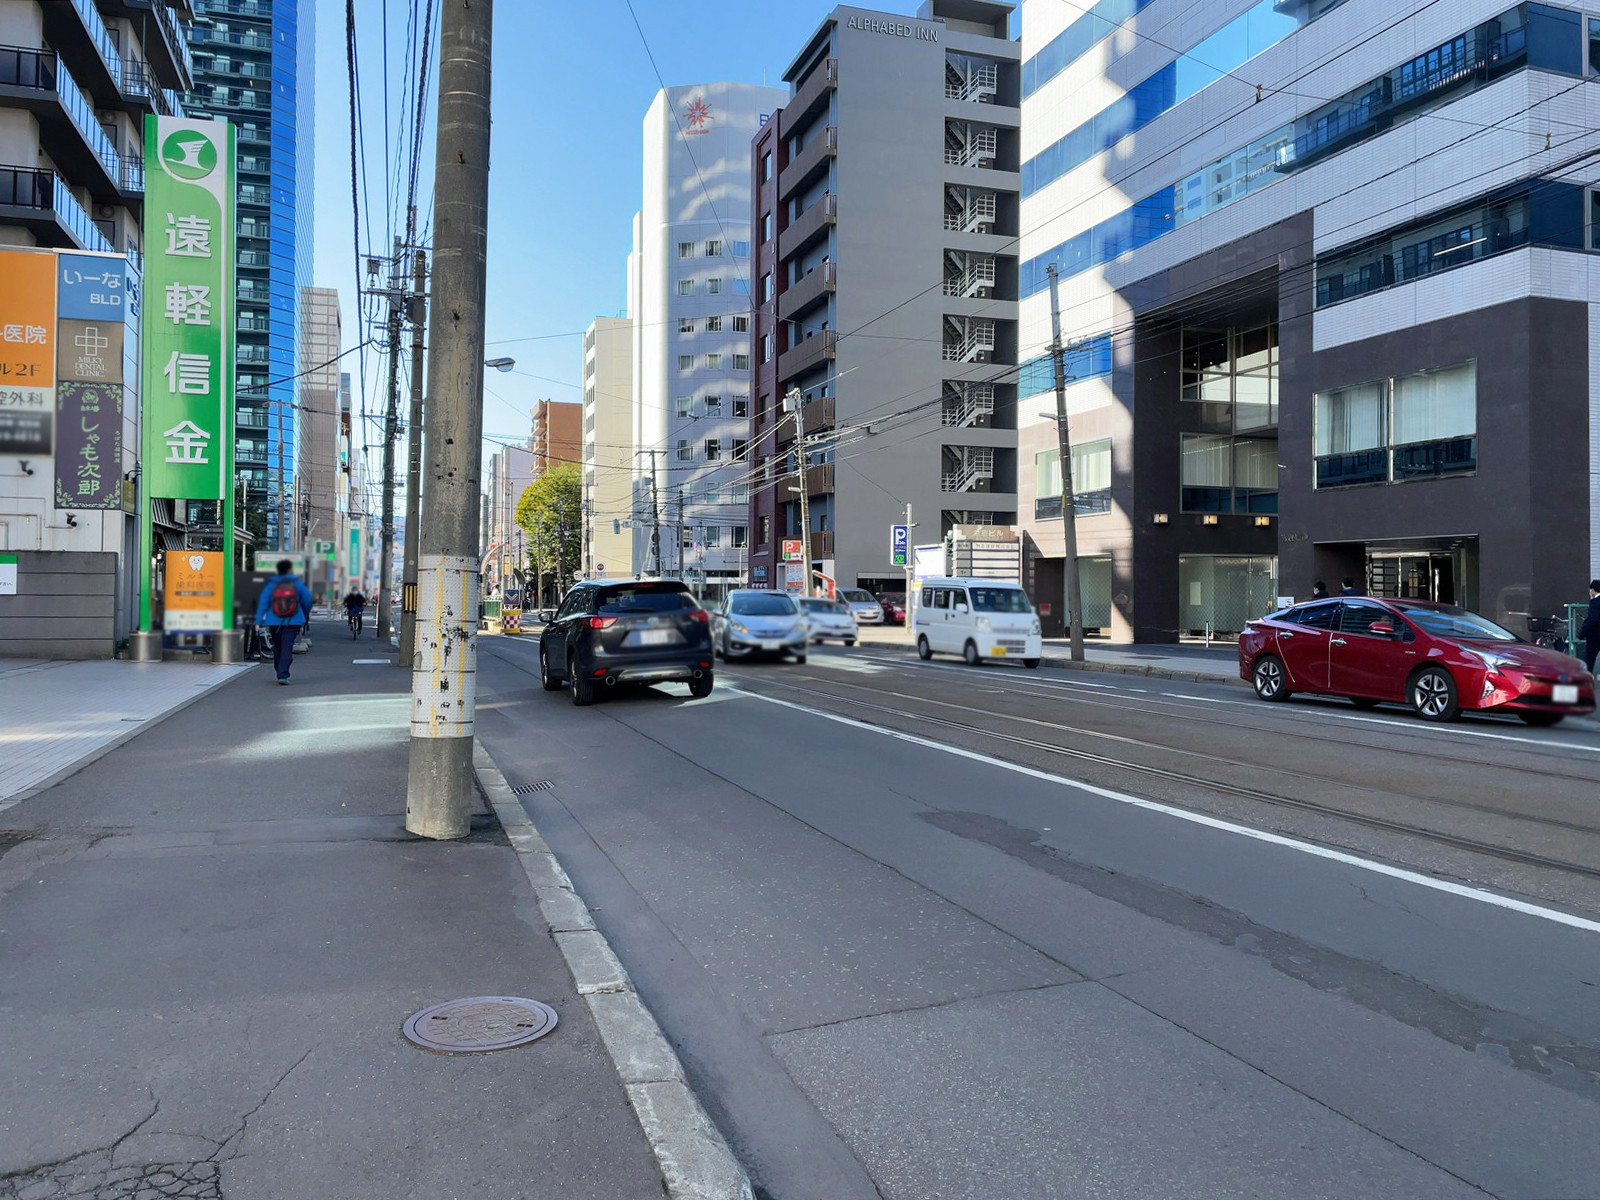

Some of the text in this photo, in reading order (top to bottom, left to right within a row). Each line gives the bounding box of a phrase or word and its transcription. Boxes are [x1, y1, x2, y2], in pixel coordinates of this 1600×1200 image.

[847, 16, 938, 42] ALPHABED INN
[63, 269, 121, 289] いーな
[90, 293, 121, 305] BLD
[0, 323, 47, 345] 医院
[164, 212, 212, 465] 遠軽信金
[78, 356, 104, 364] MILKY
[75, 362, 107, 371] DENTAL
[320, 543, 331, 553] P
[786, 542, 794, 553] P
